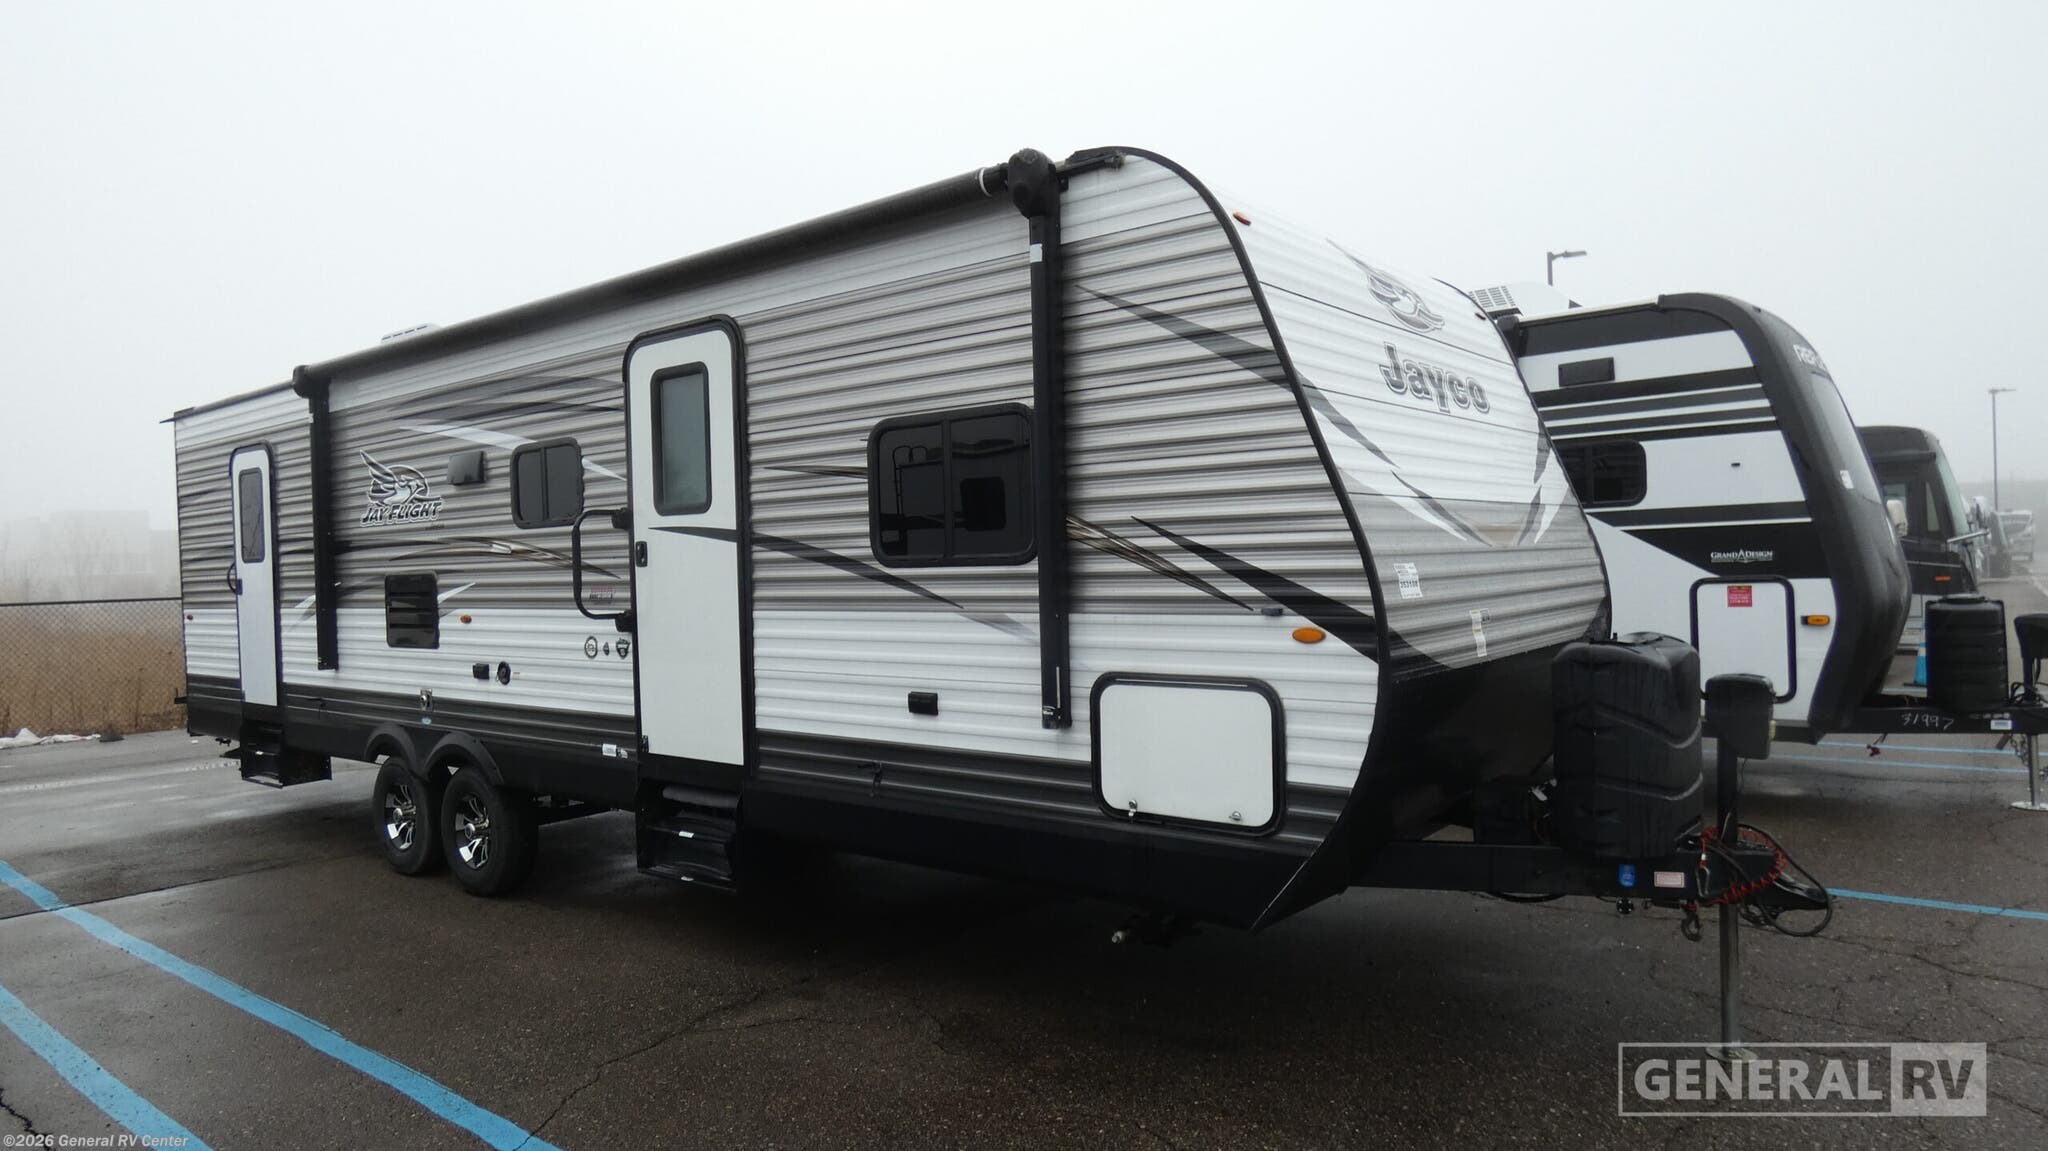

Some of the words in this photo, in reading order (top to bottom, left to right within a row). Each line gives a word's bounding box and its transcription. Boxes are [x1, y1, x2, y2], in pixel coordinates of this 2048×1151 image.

[1379, 341, 1490, 414] Jayco
[360, 505, 390, 526] JAY
[388, 499, 443, 524] FLIGHT
[1901, 712, 1954, 731] 31997
